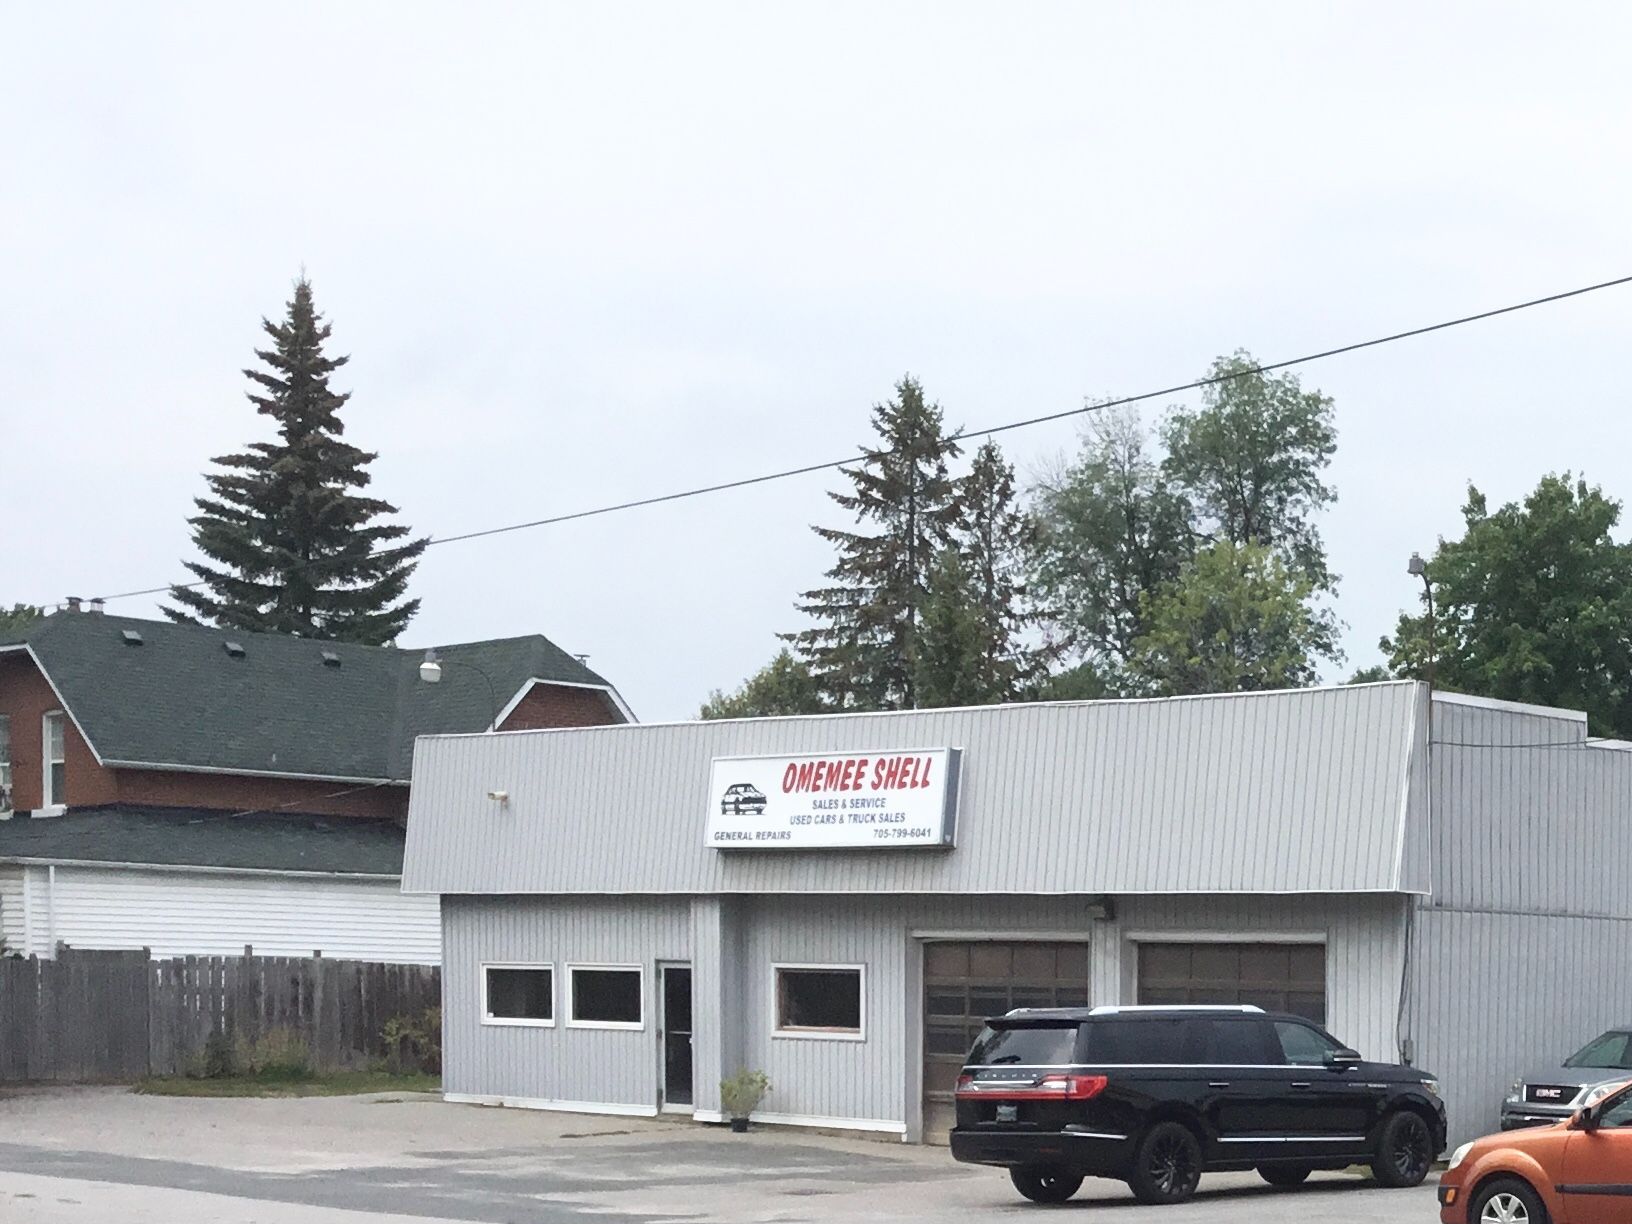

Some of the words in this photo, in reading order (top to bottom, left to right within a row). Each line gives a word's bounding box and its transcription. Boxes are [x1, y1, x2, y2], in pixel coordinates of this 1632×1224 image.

[782, 759, 868, 793] OMEMEE
[871, 757, 933, 790] SHELL
[812, 800, 839, 810] SALES
[841, 799, 847, 809] &
[849, 798, 886, 809] SERVICE
[790, 815, 812, 825] USED
[814, 814, 836, 825] CARS
[838, 814, 845, 824] &
[847, 813, 877, 824] TRUCK
[878, 812, 906, 823] SALES
[714, 831, 753, 841] GENERAL
[755, 830, 791, 840] REPAIRS
